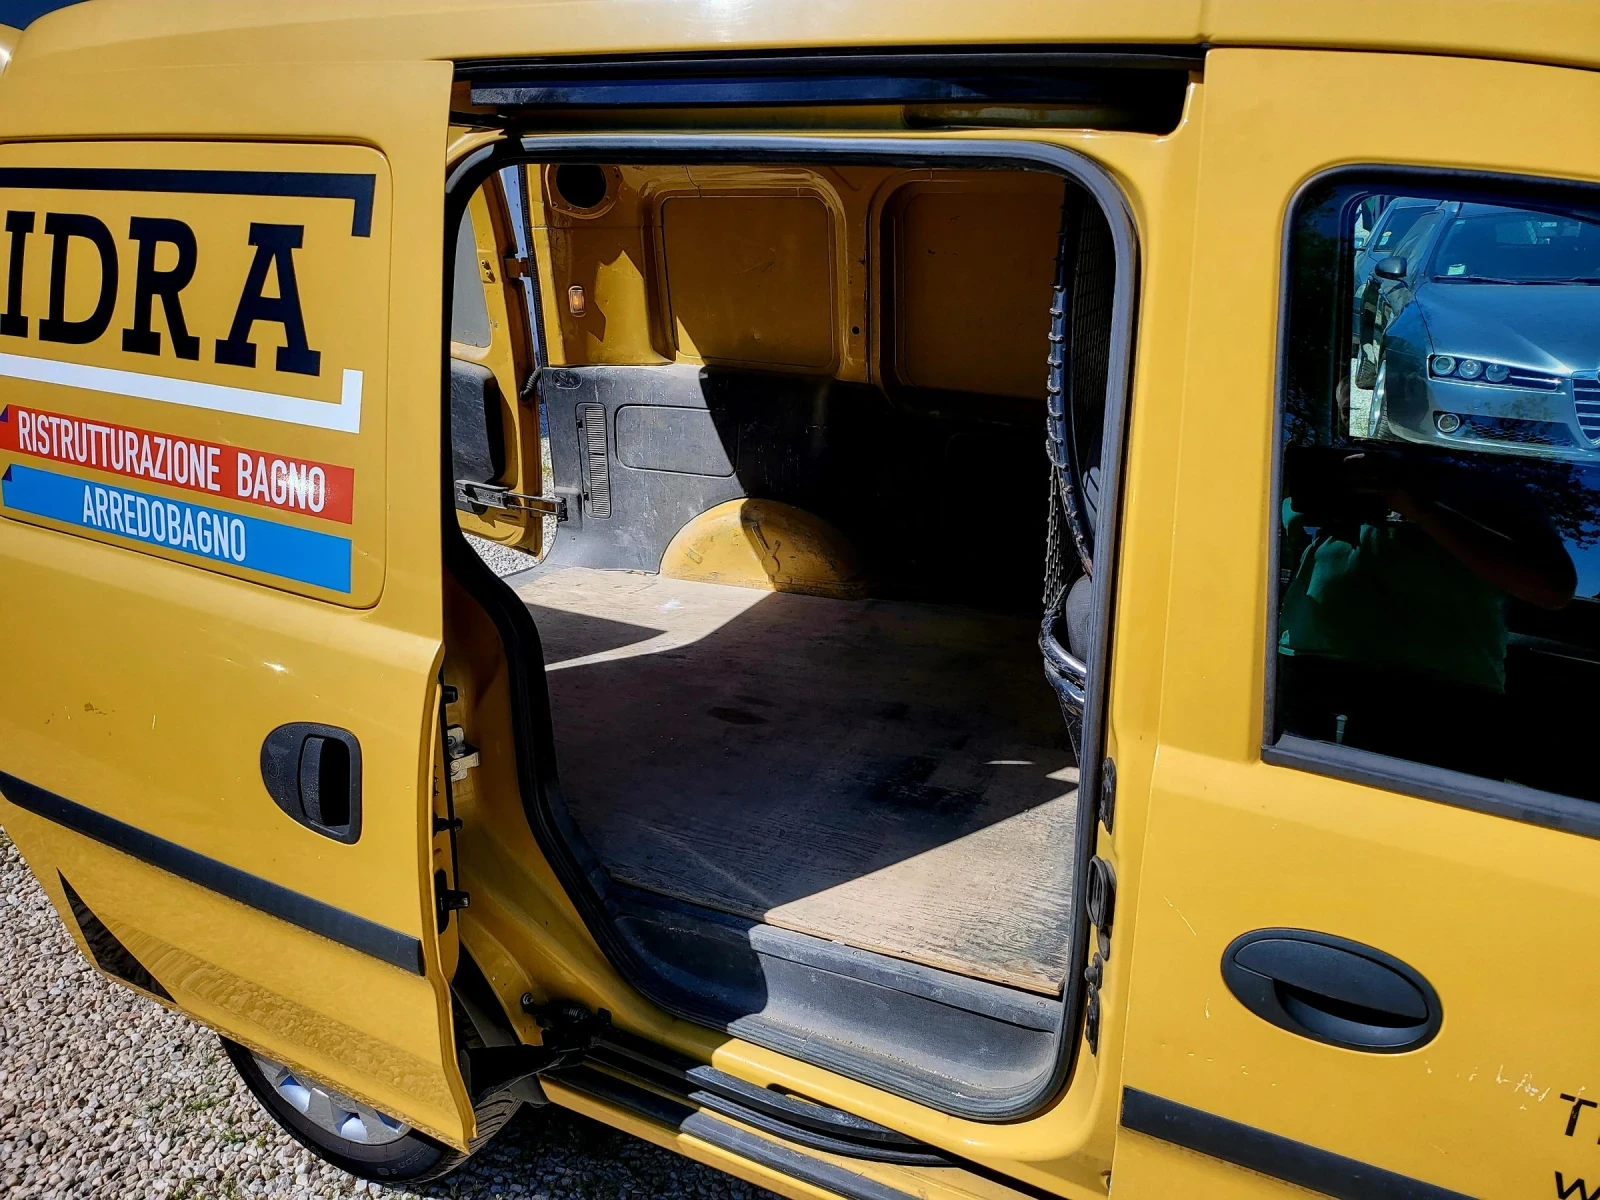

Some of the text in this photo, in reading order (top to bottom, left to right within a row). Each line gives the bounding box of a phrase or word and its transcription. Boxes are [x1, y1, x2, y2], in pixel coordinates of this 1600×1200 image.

[0, 210, 322, 377] IDRA
[17, 410, 326, 514] RISTRUTTURAZIONE BAGNO
[82, 484, 246, 562] ARREDOBAGNO
